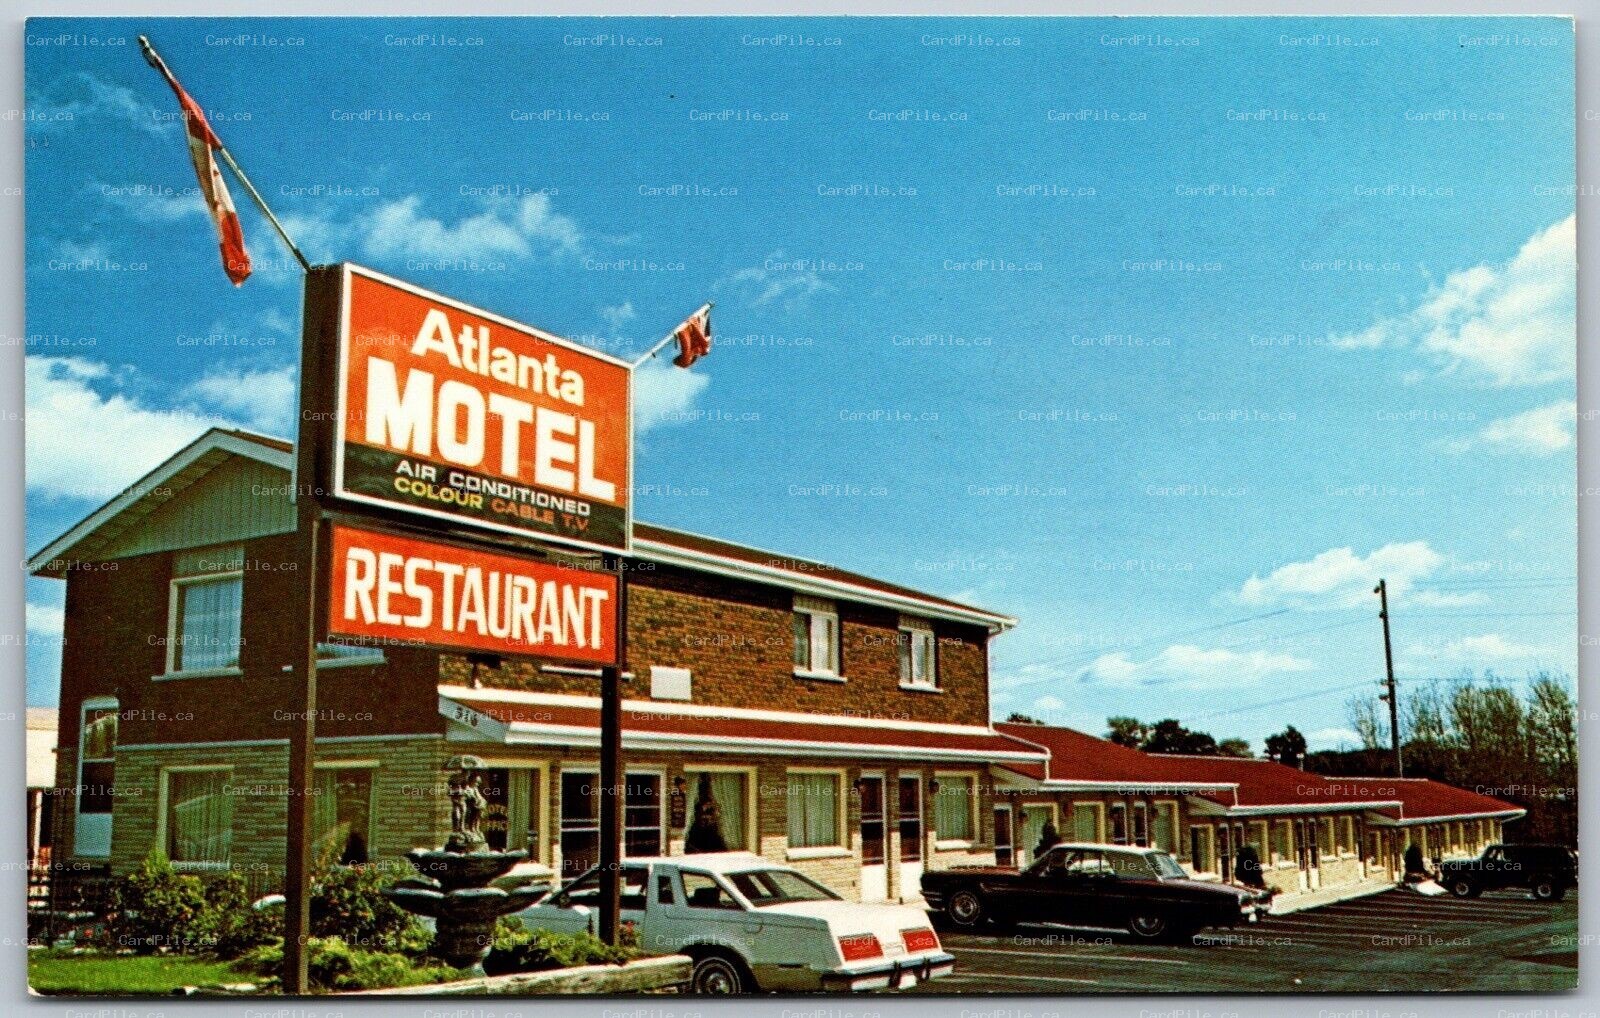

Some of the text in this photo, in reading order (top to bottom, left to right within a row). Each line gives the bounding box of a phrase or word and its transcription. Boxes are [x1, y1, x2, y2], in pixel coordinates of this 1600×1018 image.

[411, 308, 585, 405] Atlanta
[366, 356, 615, 501] MOTEL
[394, 478, 483, 509] COLOUR
[491, 498, 554, 525] CABLE
[396, 460, 590, 516] AIR CONDITIONED
[344, 547, 608, 651] RESTAURANT
